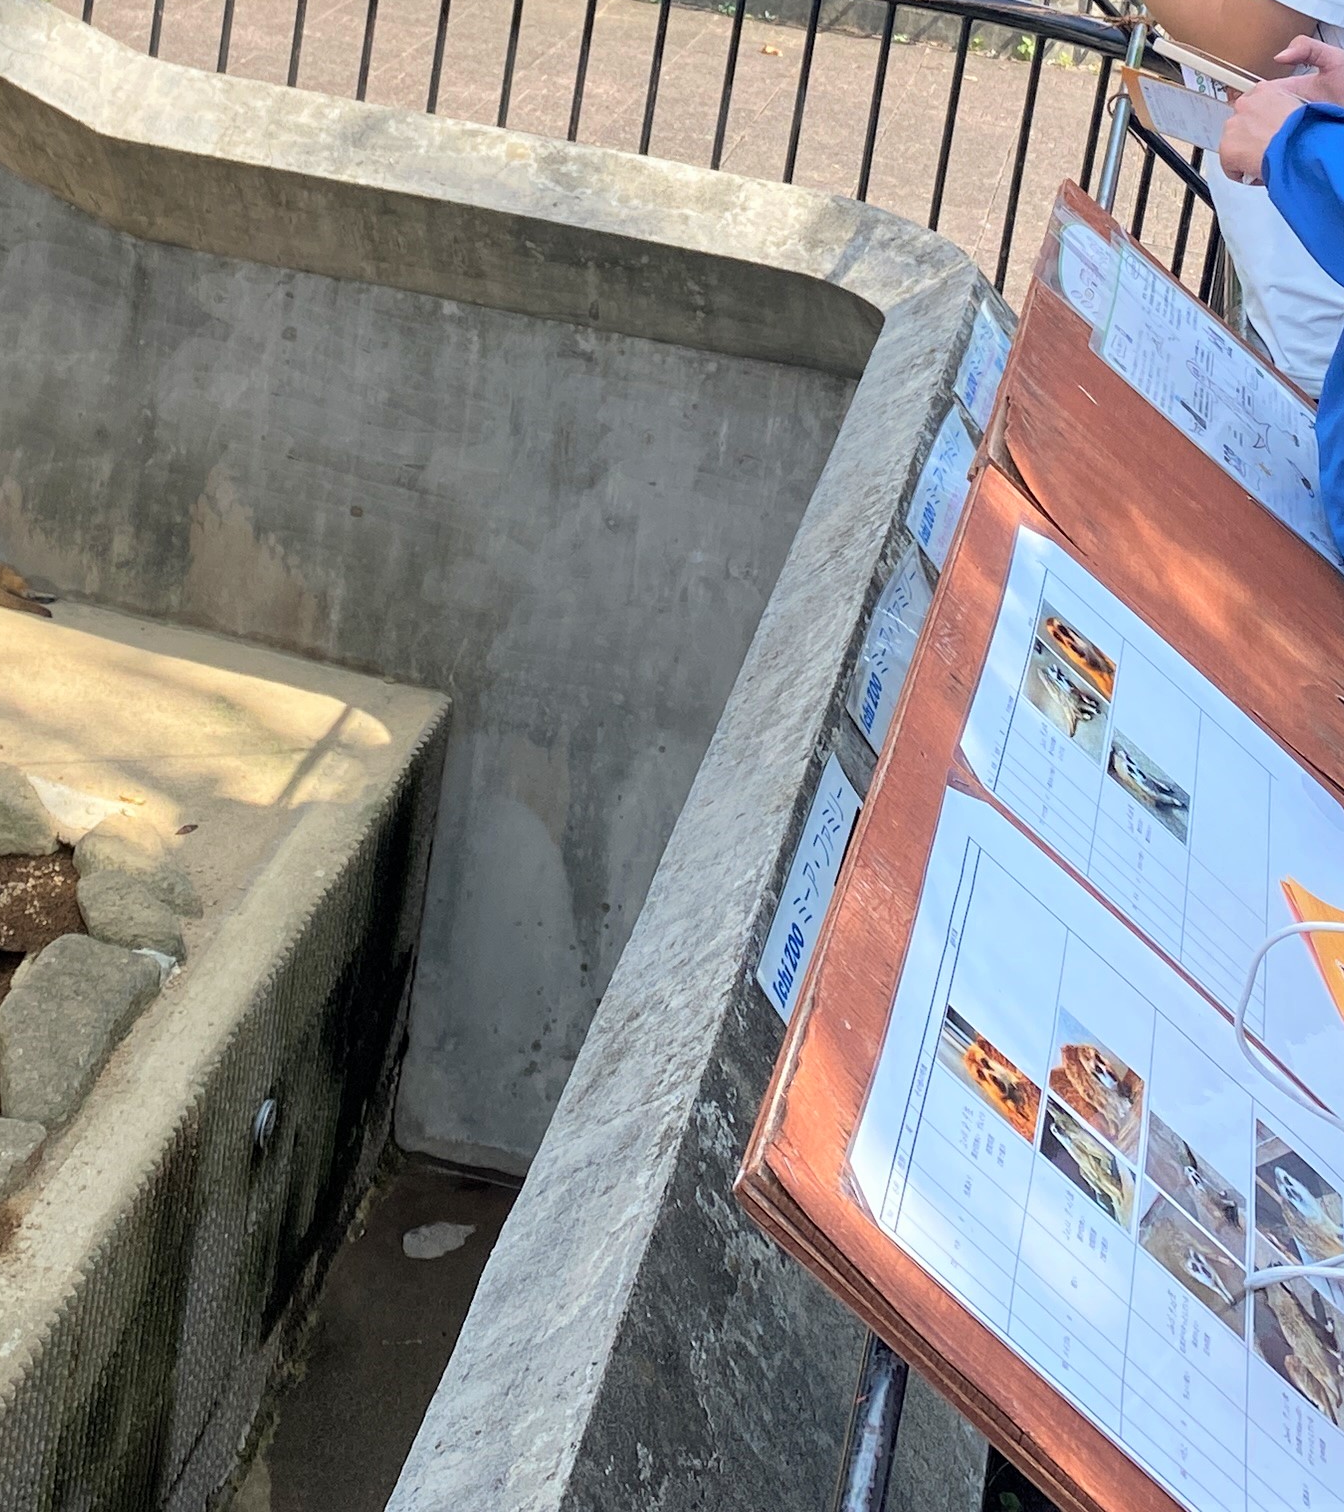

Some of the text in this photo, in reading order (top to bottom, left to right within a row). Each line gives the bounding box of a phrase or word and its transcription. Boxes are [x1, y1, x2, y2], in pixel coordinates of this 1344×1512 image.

[866, 671, 883, 711] ZOO
[772, 957, 794, 1010] Ichi
[784, 921, 805, 972] ZOO
